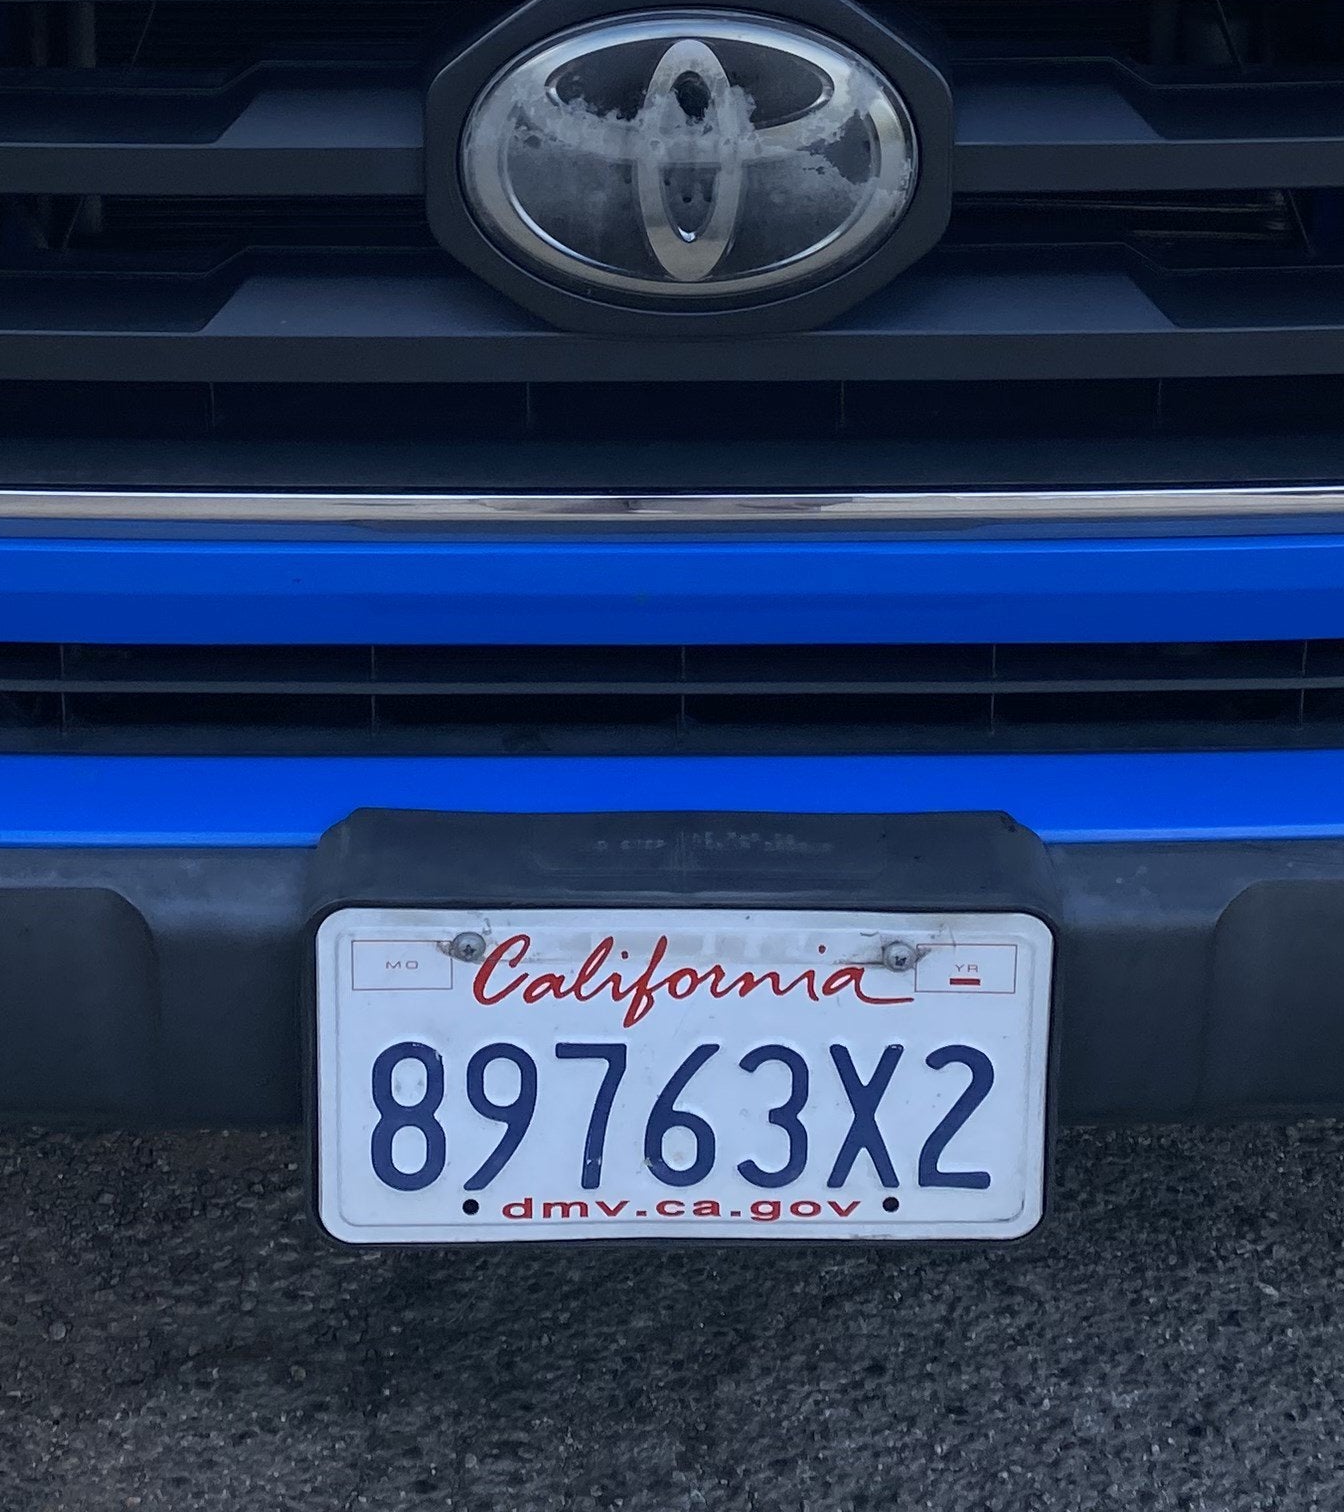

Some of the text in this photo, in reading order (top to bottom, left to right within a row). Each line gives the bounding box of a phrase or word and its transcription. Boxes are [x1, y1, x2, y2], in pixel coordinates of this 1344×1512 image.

[385, 959, 420, 971] MO
[954, 963, 979, 974] YR
[473, 934, 915, 1028] California
[370, 1041, 996, 1192] 89763X2
[501, 1196, 863, 1222] dmv.ca.gov
